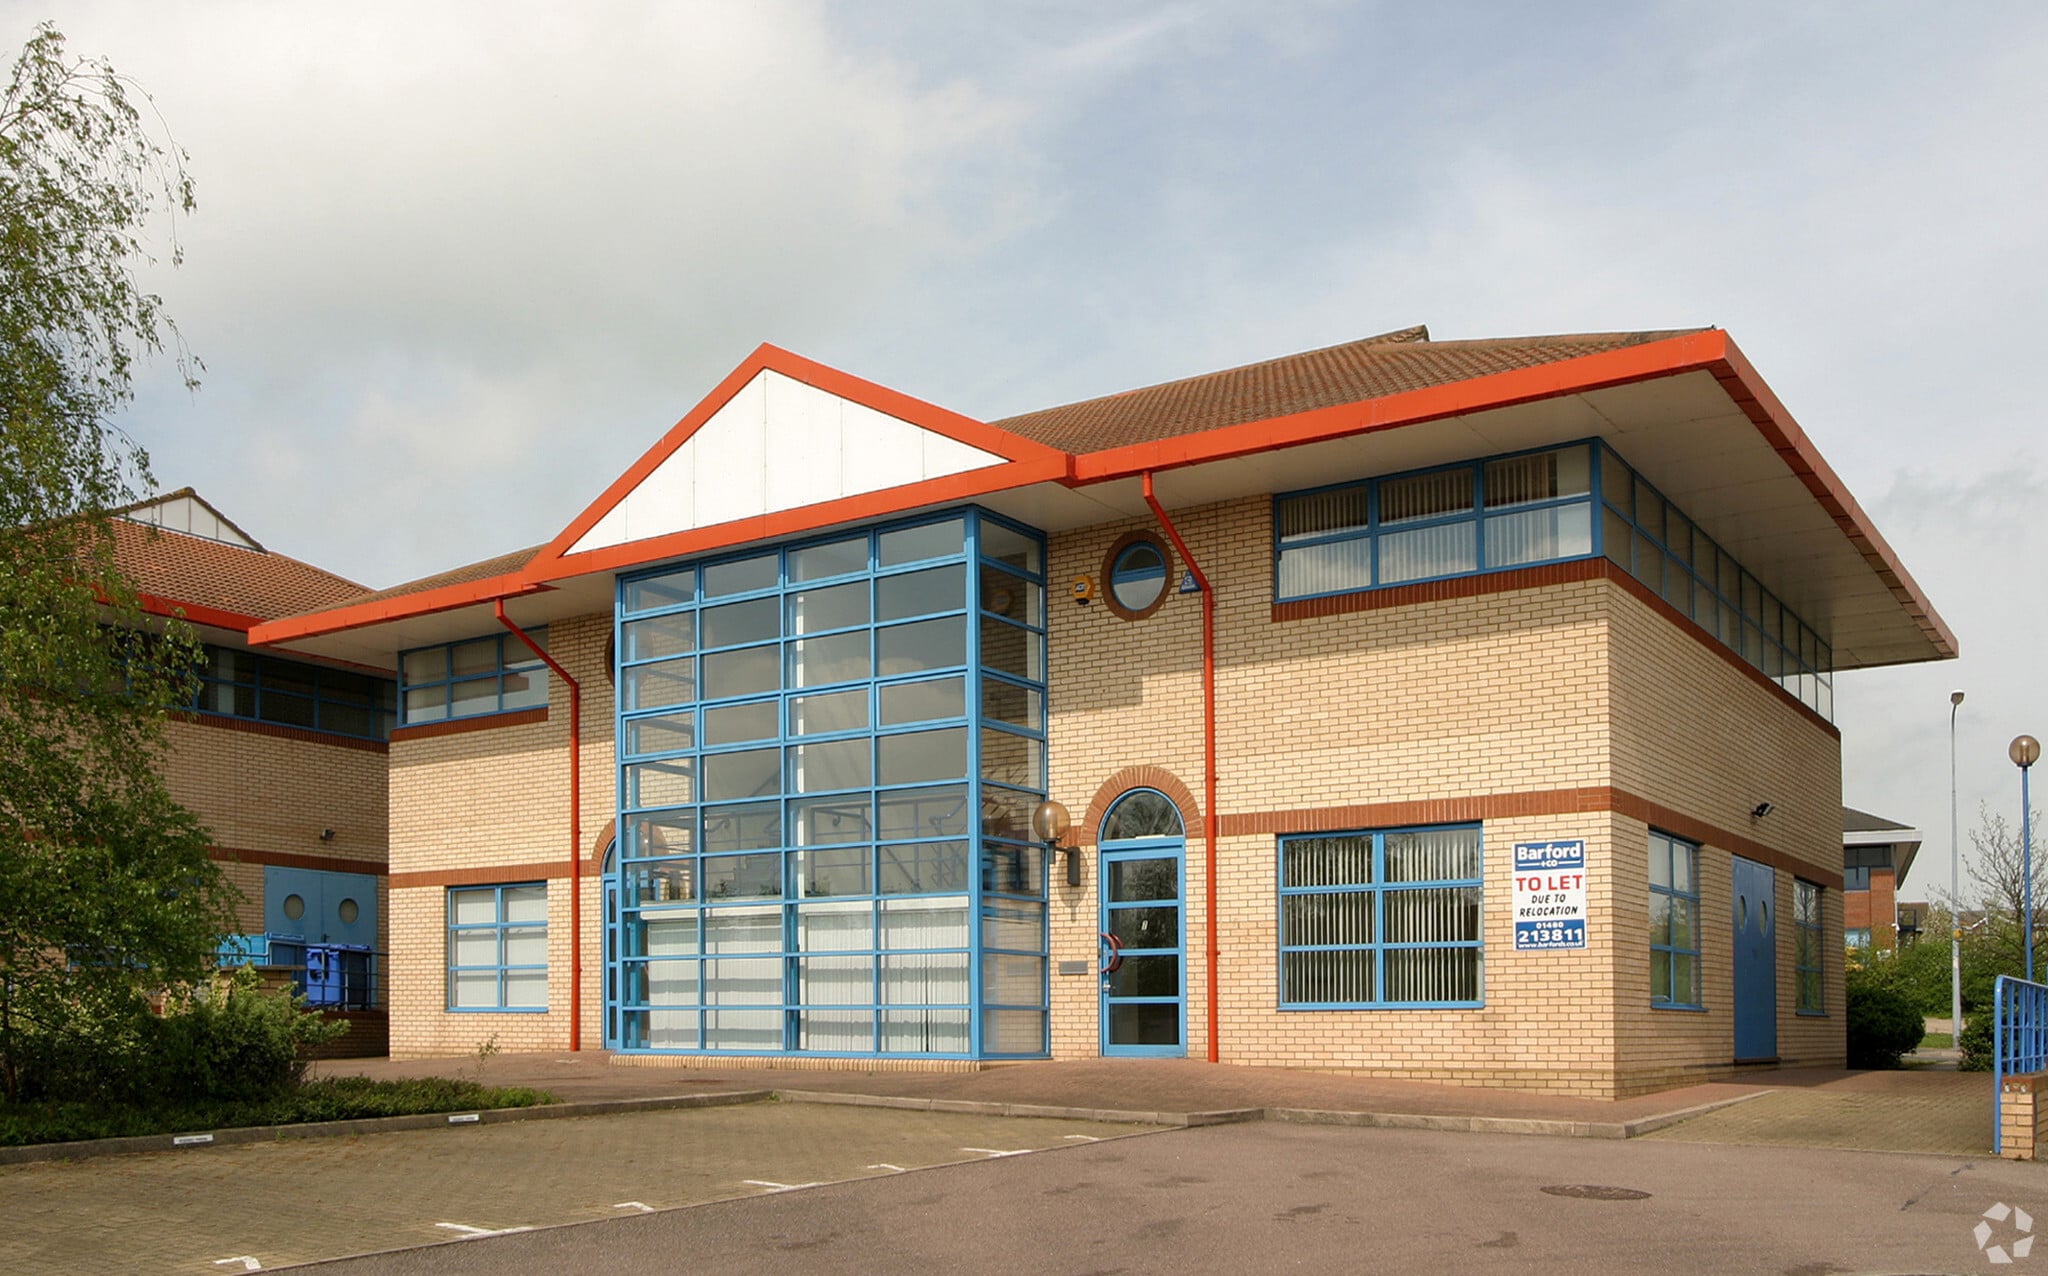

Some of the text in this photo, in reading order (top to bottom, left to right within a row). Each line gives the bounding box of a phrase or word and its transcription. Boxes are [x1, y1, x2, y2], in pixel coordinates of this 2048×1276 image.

[1517, 843, 1581, 860] Barford
[1515, 875, 1583, 891] TO LET
[1531, 893, 1566, 904] DUE TO
[1519, 906, 1578, 917] RELOCATION
[1518, 928, 1583, 942] 213811
